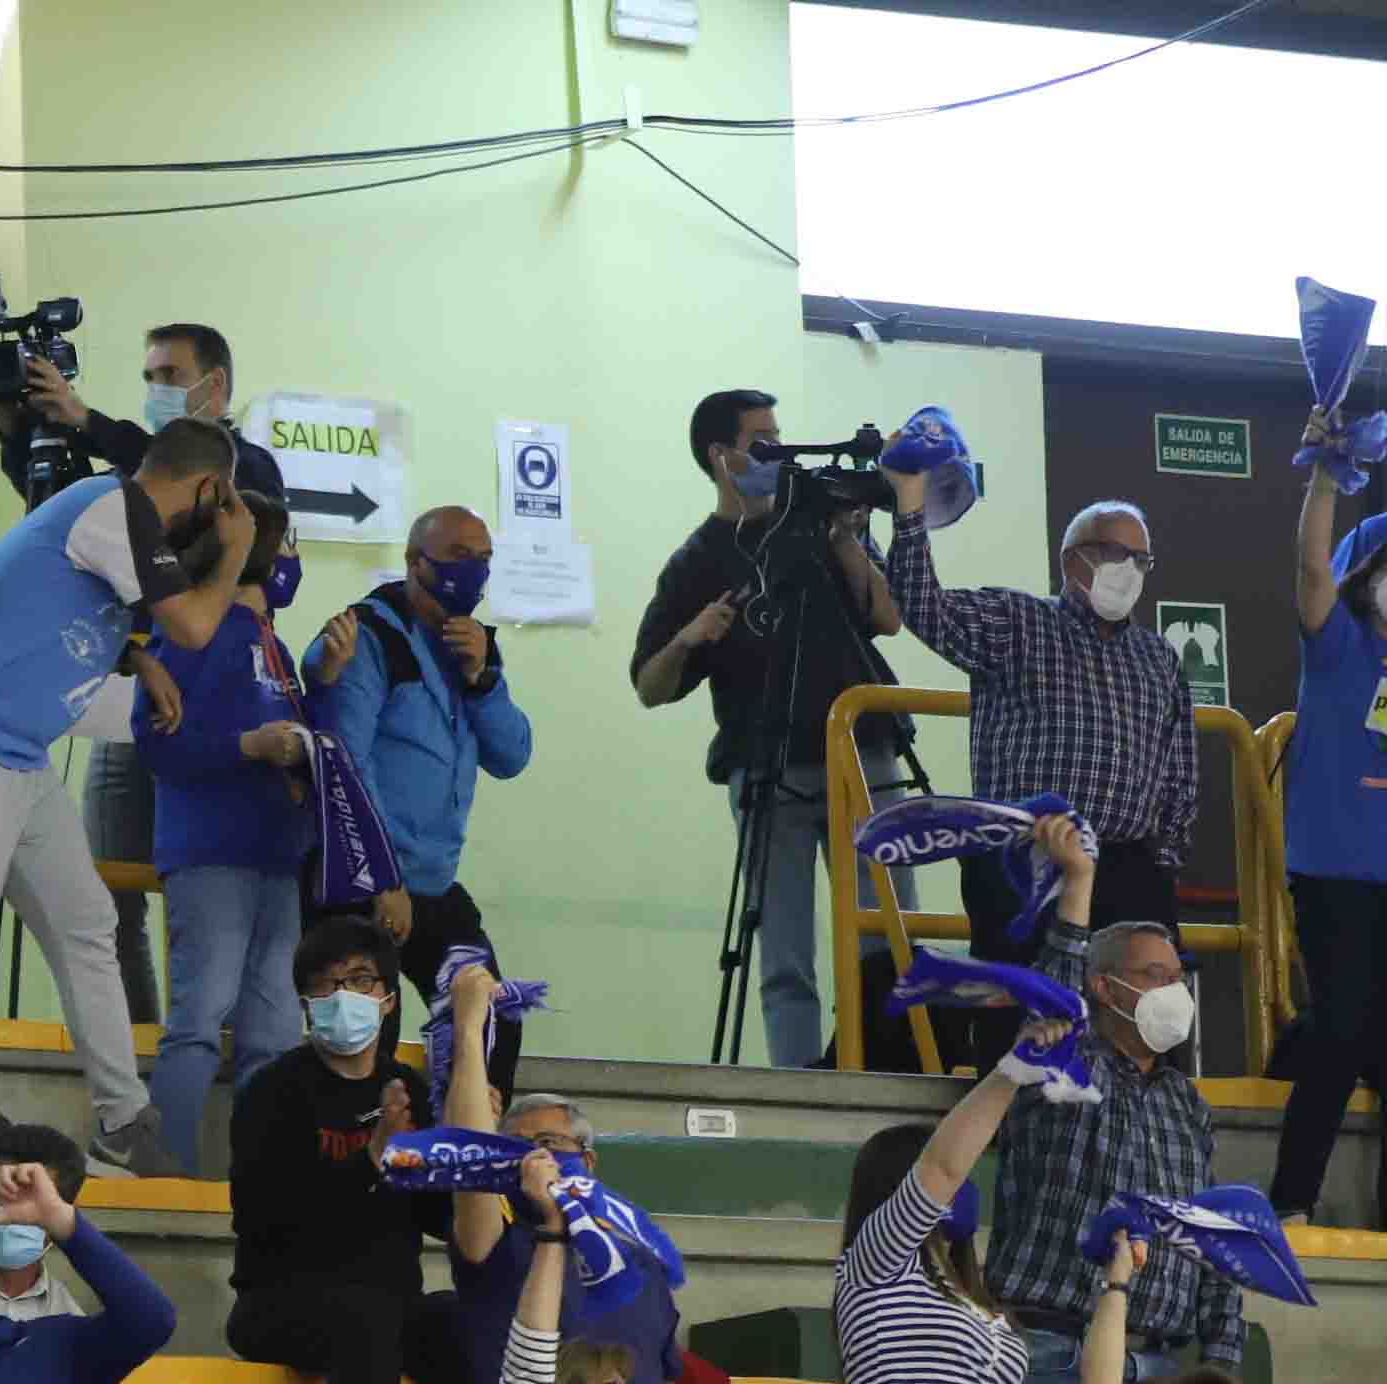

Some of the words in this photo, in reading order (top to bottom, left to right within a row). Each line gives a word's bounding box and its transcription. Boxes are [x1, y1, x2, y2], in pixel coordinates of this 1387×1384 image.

[272, 421, 379, 457] SALIDA
[1169, 427, 1212, 443] SALIDA
[1218, 431, 1235, 446] DE
[1162, 447, 1243, 465] EMERGENCIA
